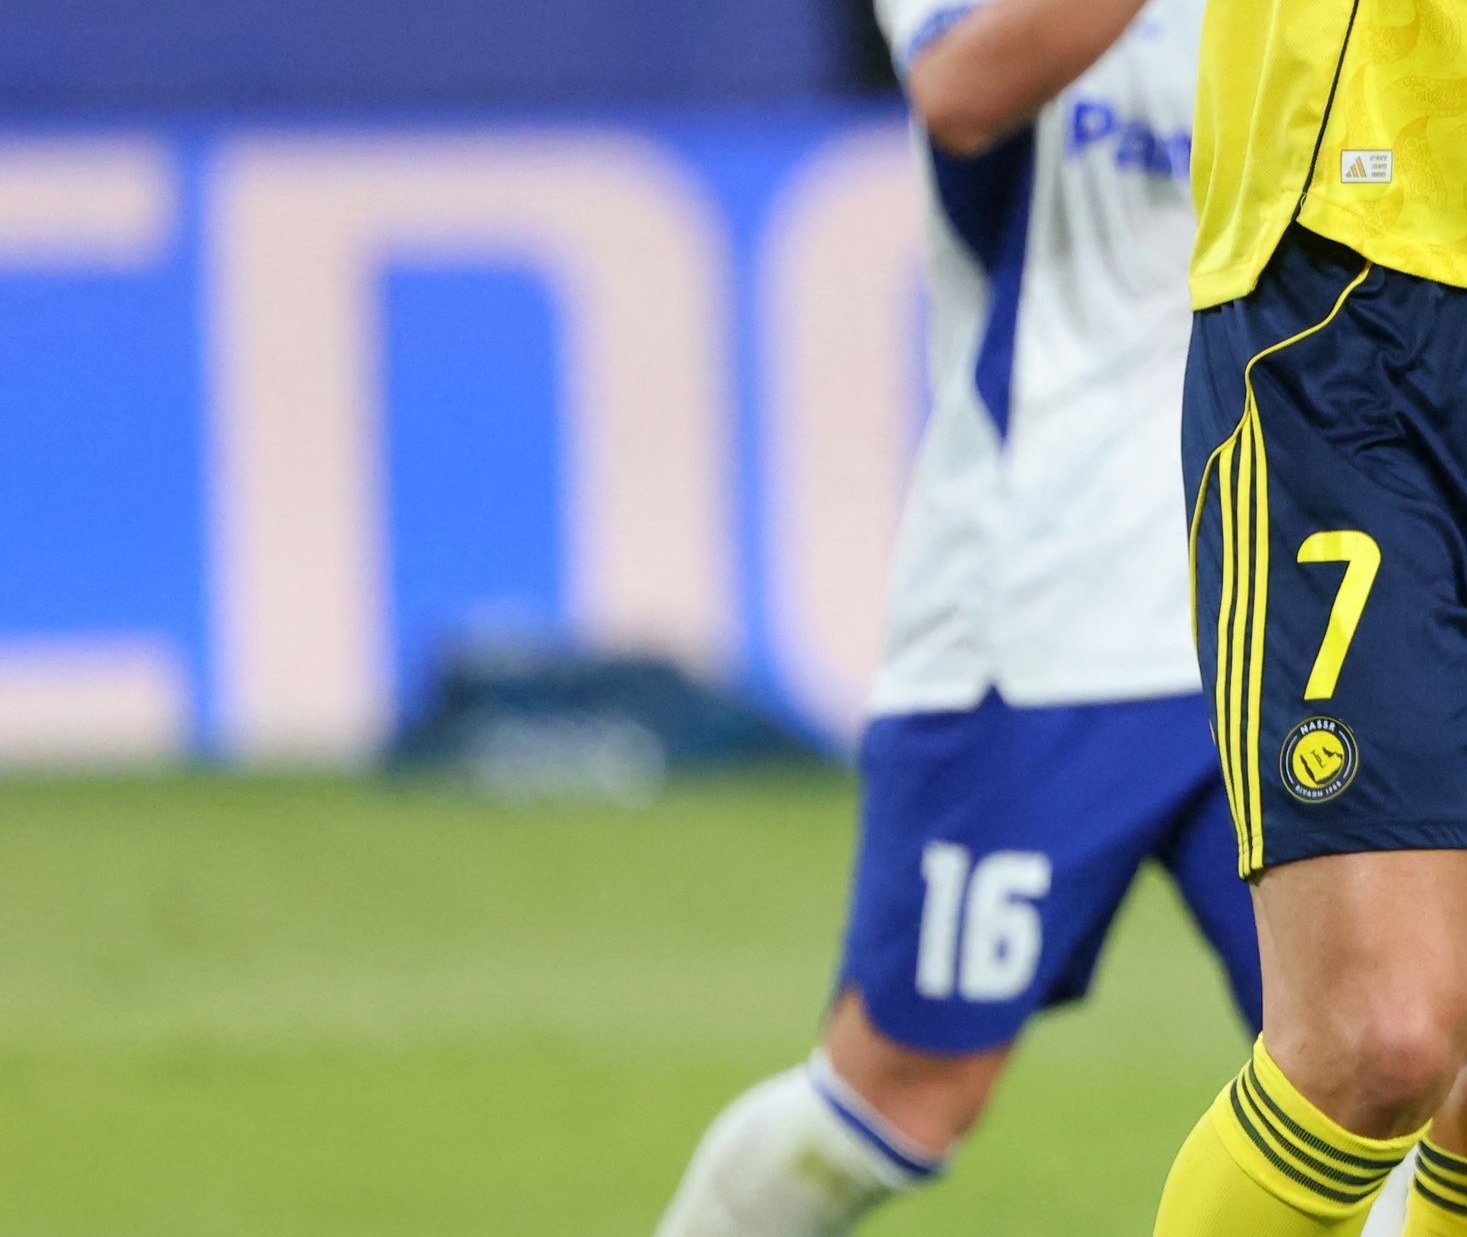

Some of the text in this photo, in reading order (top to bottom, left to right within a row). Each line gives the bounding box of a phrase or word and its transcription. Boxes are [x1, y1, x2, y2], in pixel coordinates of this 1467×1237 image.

[1296, 529, 1382, 701] 7
[1300, 719, 1335, 736] NASSR
[914, 840, 1052, 1003] 16
